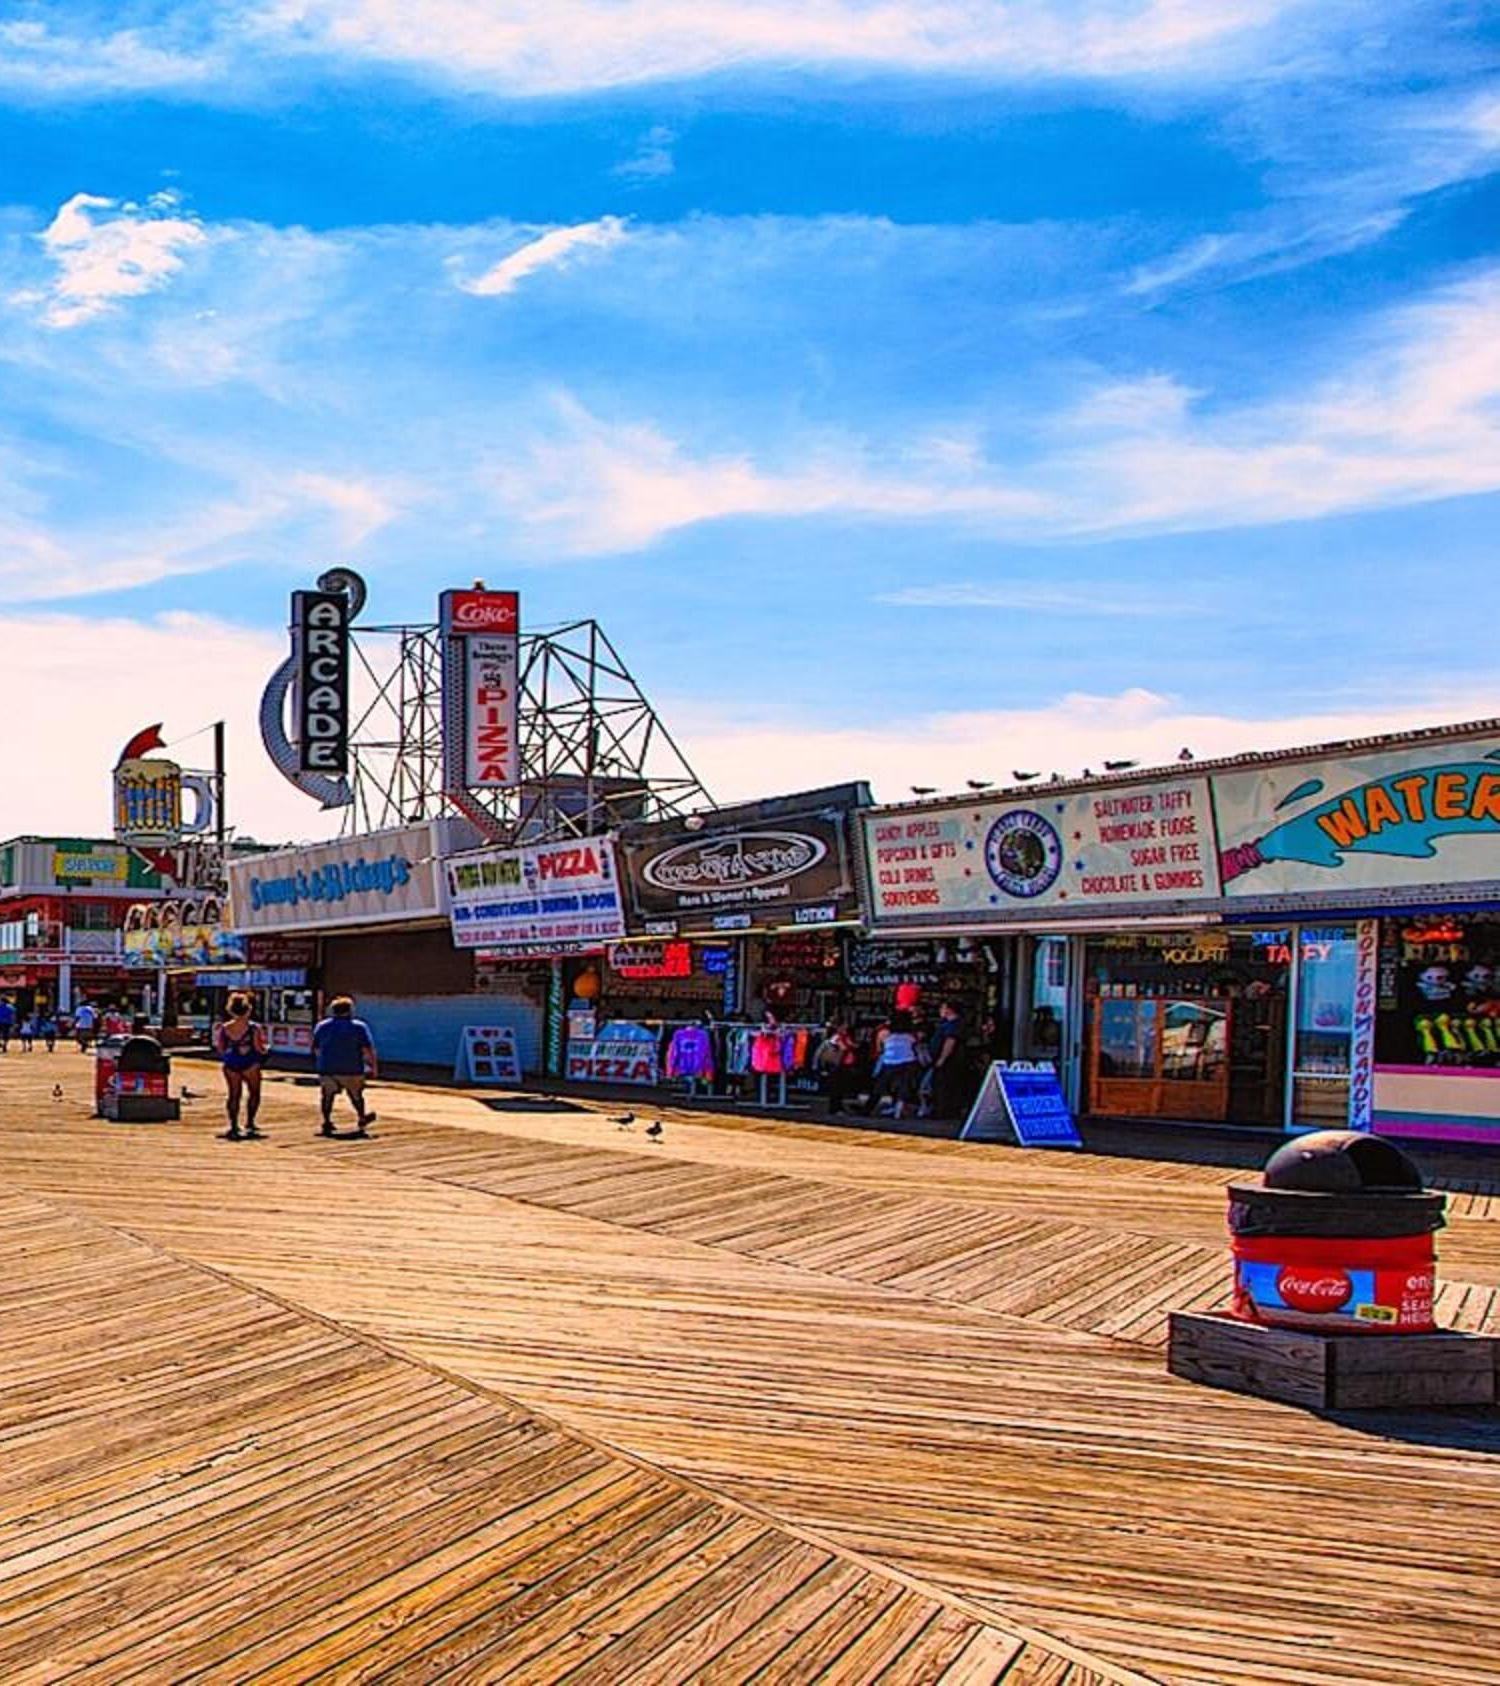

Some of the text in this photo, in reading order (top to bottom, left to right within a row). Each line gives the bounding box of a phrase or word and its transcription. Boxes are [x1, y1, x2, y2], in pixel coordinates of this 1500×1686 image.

[306, 601, 341, 768] ARCADE
[476, 687, 509, 781] PIZZA
[1315, 772, 1500, 849] WATER
[1099, 815, 1198, 842] HOMEMADE FUDGE
[877, 846, 917, 862] POPCORN
[930, 841, 957, 859] GIFTS
[1131, 842, 1200, 867] SUGAR FREE
[537, 847, 600, 880] PIZZA
[1081, 874, 1139, 894] CHOCOLATE
[581, 892, 617, 909] ROOM
[881, 889, 940, 907] SOUVENIRS
[794, 905, 837, 922] LOTION
[613, 942, 663, 955] ATM
[1251, 930, 1289, 946] SALT
[1266, 944, 1332, 963] TAFY
[1357, 919, 1375, 1014] COTTON
[569, 1058, 652, 1080] PIZZA
